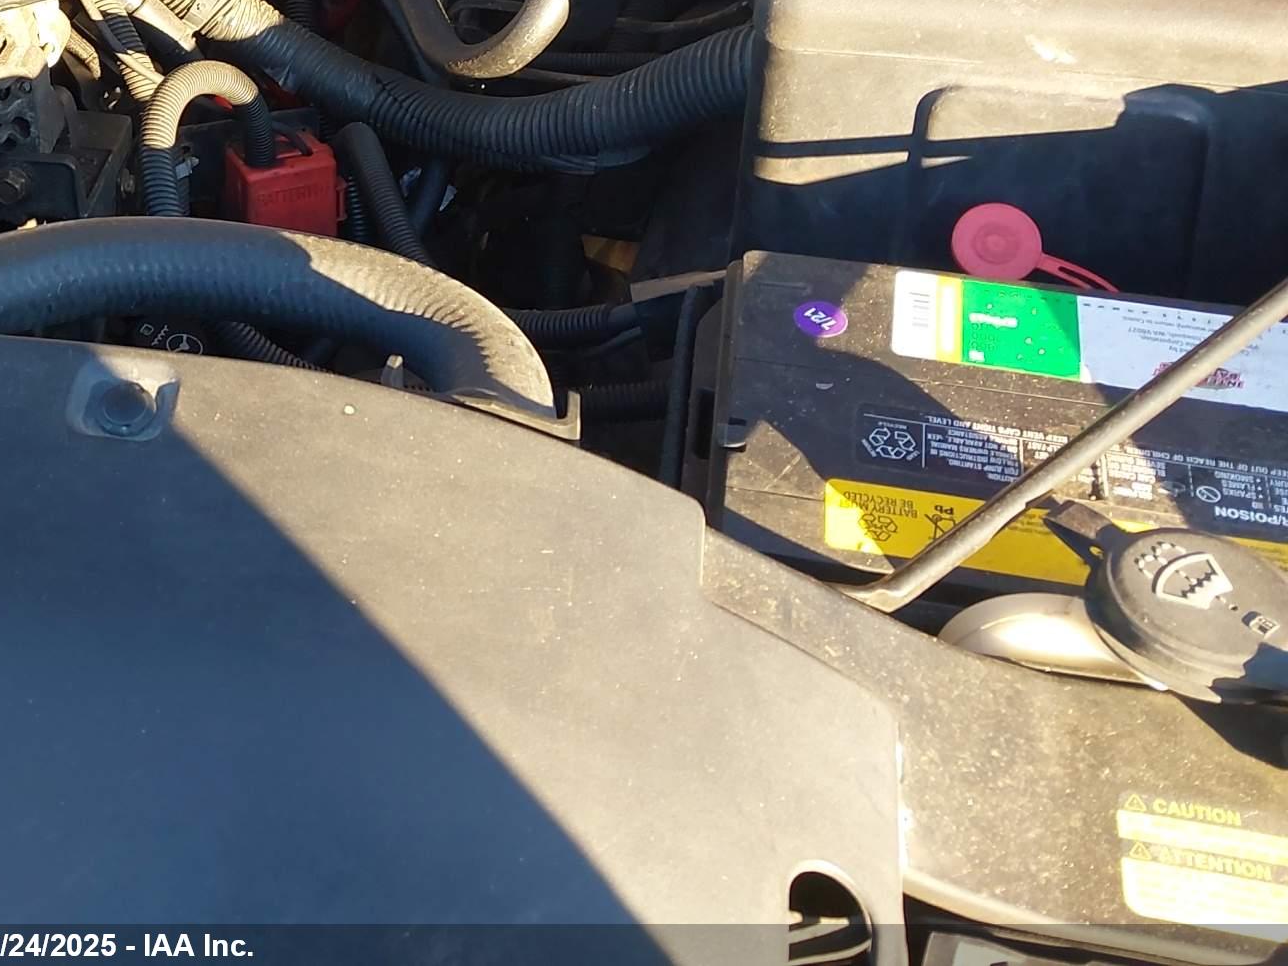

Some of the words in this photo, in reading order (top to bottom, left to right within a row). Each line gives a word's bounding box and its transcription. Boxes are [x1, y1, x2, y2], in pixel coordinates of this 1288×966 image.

[803, 307, 838, 331] 7/21
[953, 419, 970, 428] AND
[1171, 453, 1184, 462] OF
[1185, 455, 1216, 467] REACH
[983, 463, 1002, 474] JUMP
[1217, 459, 1234, 470] THE
[1236, 463, 1249, 472] OF
[1250, 465, 1269, 475] OUT
[1004, 467, 1019, 476] FOR
[1214, 470, 1255, 484] SMOKING
[1221, 479, 1256, 491] FLAMES
[843, 490, 897, 505] RECYCLED
[1222, 487, 1257, 500] SPARKS
[900, 498, 914, 509] BE
[871, 505, 918, 519] BATTERY
[934, 504, 954, 515] Pb
[1152, 798, 1242, 826] CAUTION
[1158, 846, 1272, 881] ATTENTION
